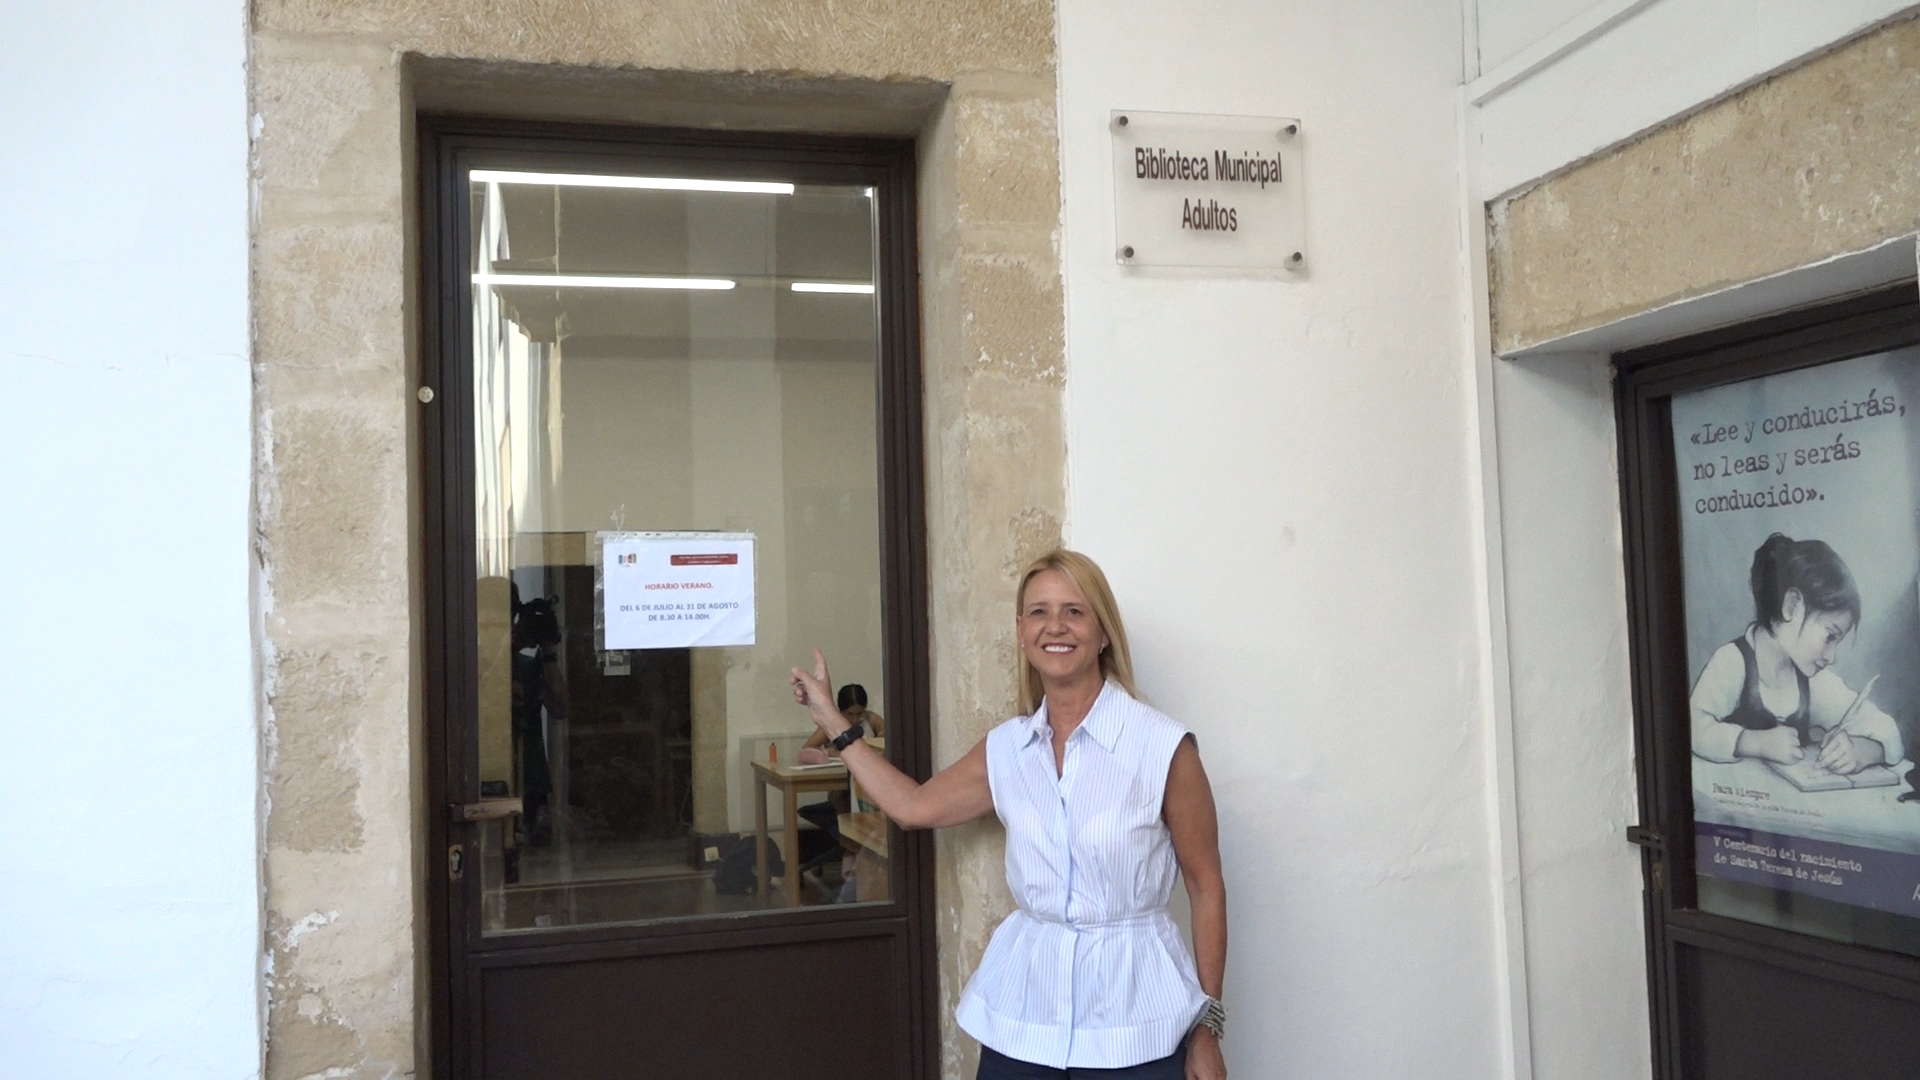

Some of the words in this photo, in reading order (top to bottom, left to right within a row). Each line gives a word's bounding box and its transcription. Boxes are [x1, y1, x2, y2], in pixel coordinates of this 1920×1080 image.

[1135, 147, 1209, 181] Biblioteca
[1214, 150, 1283, 190] Municipal
[1182, 198, 1238, 232] Adultos
[1690, 422, 1739, 445] «Lee
[1744, 421, 1757, 444] y
[1762, 388, 1906, 435] conducirás,
[1693, 461, 1716, 481] no
[1721, 454, 1770, 478] leas
[1775, 451, 1788, 476] y
[1795, 433, 1861, 466] serás
[1695, 483, 1825, 514] conducido».
[644, 582, 679, 591] HORARIO
[681, 581, 714, 590] VERANO.
[620, 604, 634, 612] DEL
[653, 603, 674, 611] JULIO
[697, 602, 706, 610] DE
[708, 602, 739, 610] AGOSTO
[1713, 836, 1721, 847] V
[1723, 838, 1777, 858] Centenario
[1779, 848, 1797, 862] del
[1800, 852, 1863, 872] nacimiento
[1713, 852, 1727, 864] de
[1730, 854, 1759, 870] Santa
[1760, 859, 1794, 877] Teresa
[1795, 866, 1808, 880] de
[1811, 869, 1843, 886] Jesús
